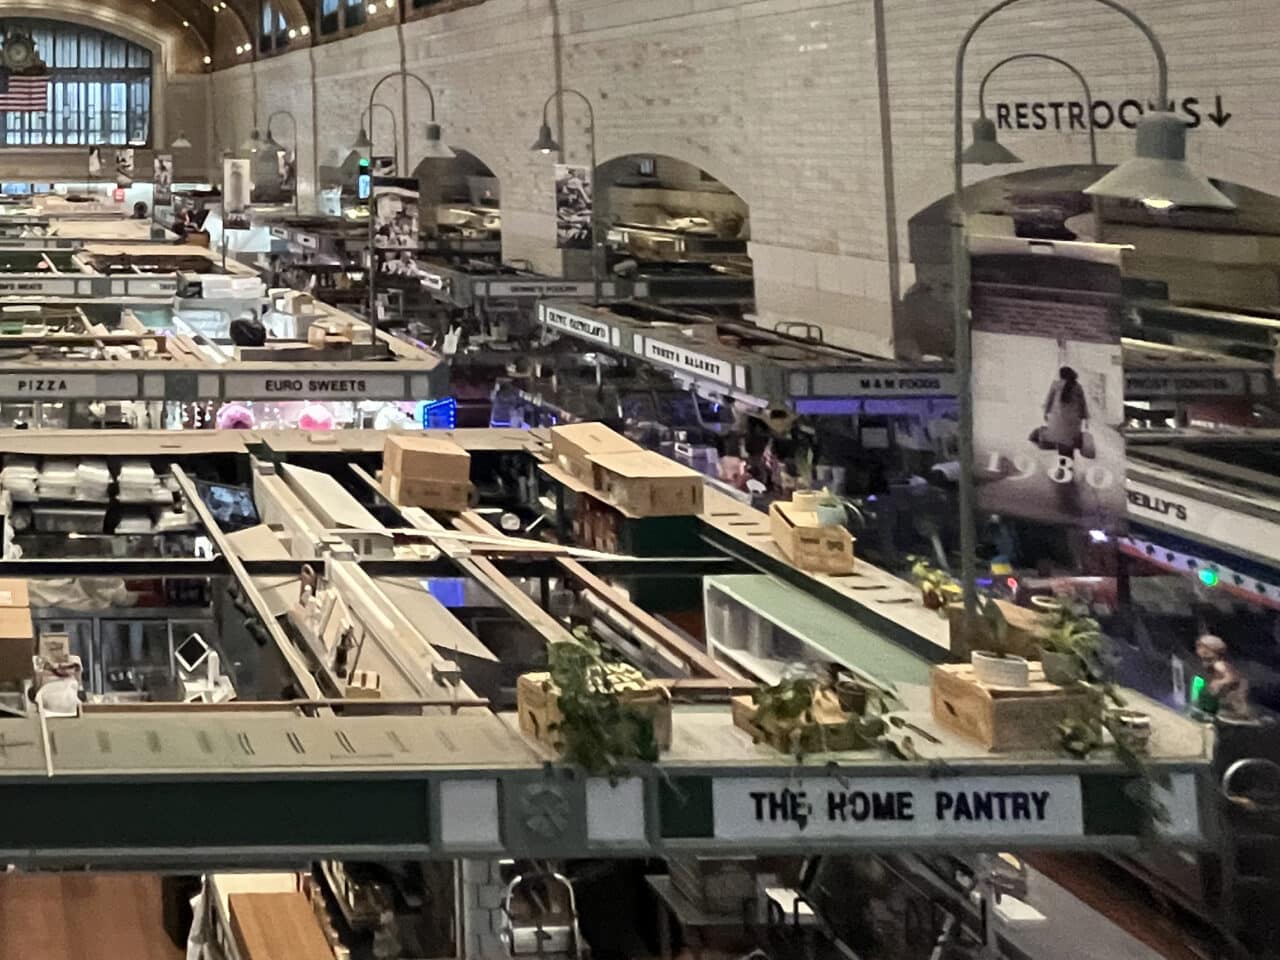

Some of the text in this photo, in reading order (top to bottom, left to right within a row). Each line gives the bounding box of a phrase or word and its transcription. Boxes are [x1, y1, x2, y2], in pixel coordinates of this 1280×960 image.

[996, 97, 1201, 130] RESTROOS
[18, 379, 68, 392] PIZZA
[265, 379, 367, 392] EURO SWEETS
[860, 378, 871, 389] M
[884, 378, 895, 389] M
[749, 790, 1050, 822] THE HOME PANTRY
